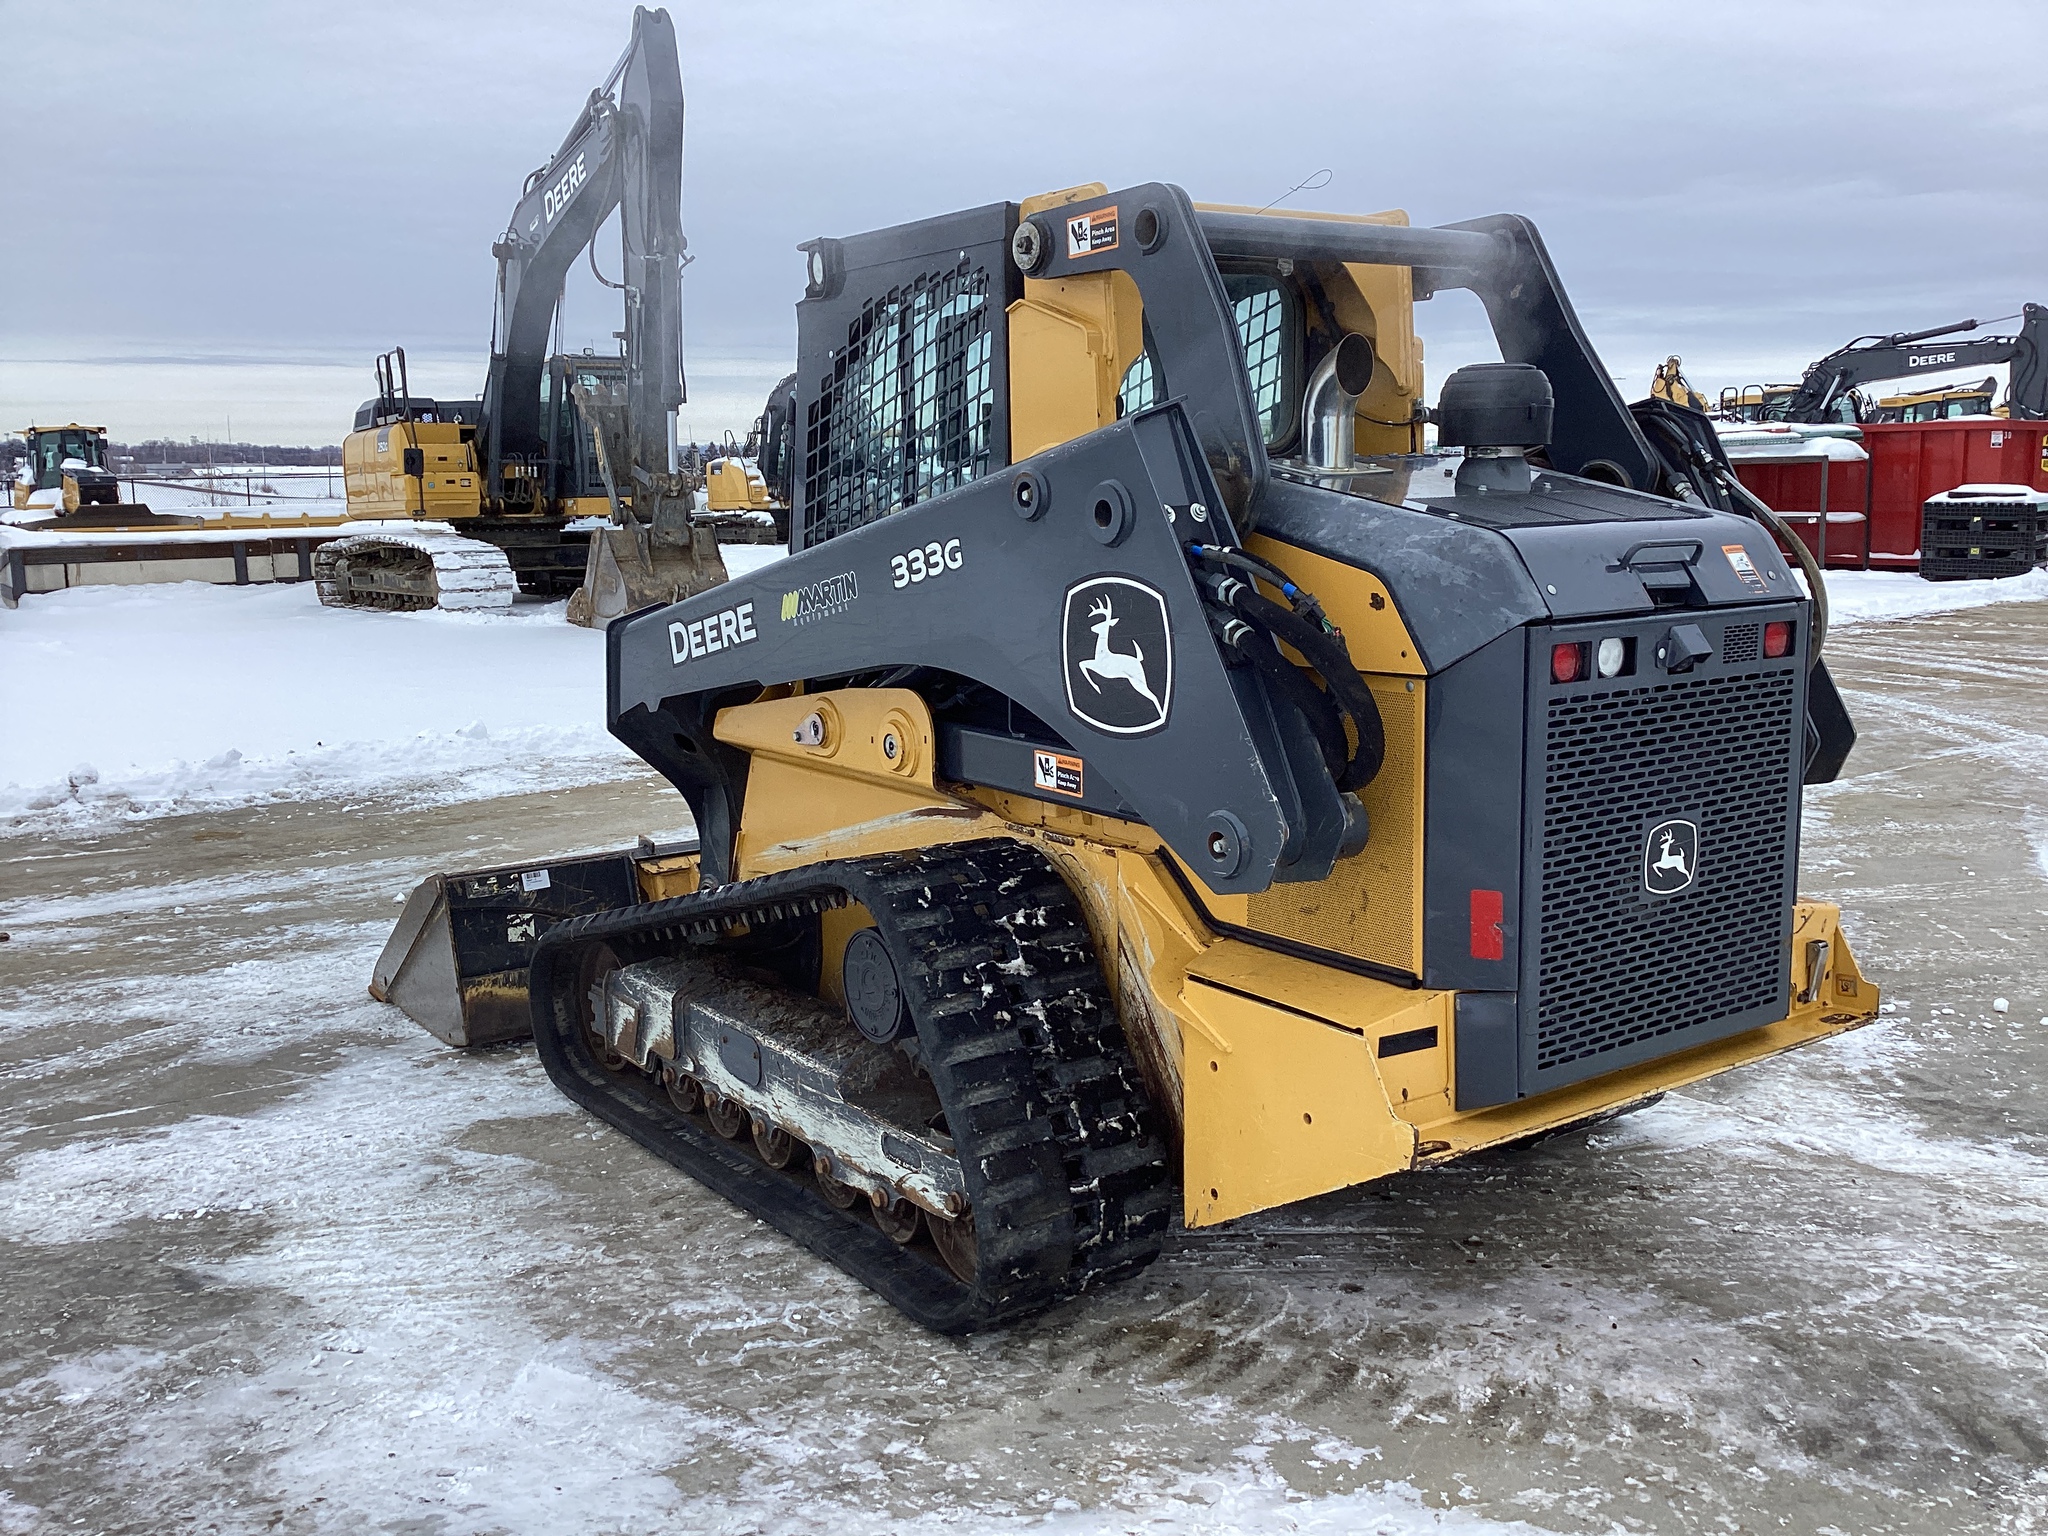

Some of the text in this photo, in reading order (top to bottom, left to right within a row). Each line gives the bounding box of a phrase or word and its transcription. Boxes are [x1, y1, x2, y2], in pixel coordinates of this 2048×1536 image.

[544, 151, 587, 224] DEERE
[1092, 228, 1104, 237] Pinch
[1908, 352, 1956, 368] DEERE
[890, 538, 963, 589] 333G
[796, 571, 858, 617] MARTIN
[668, 602, 757, 665] DEERE
